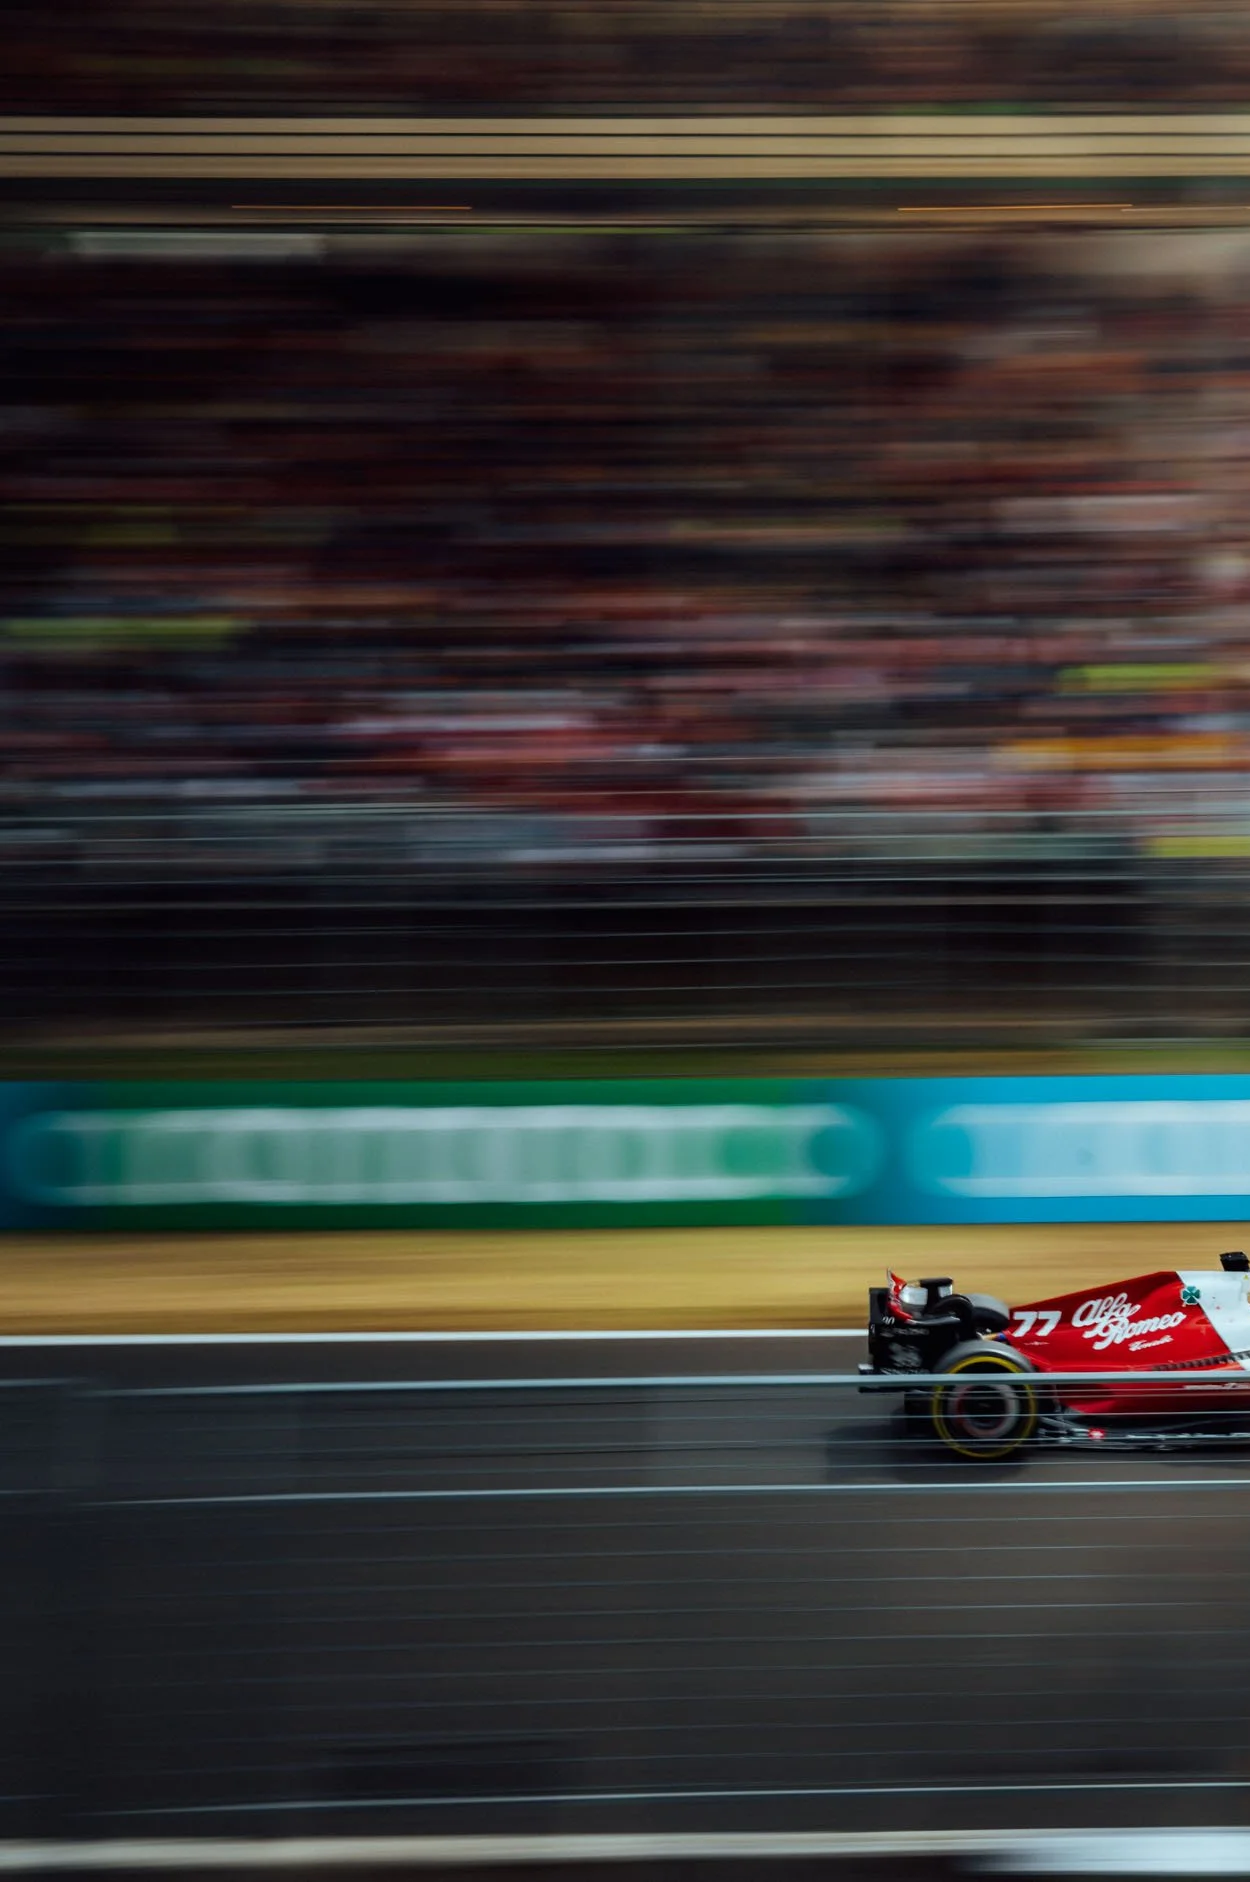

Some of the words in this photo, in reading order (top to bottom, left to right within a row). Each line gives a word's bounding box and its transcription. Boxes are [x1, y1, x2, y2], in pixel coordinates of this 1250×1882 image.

[1012, 1310, 1062, 1338] 77
[1071, 1292, 1141, 1328] Alfa
[1082, 1311, 1187, 1350] Romeo
